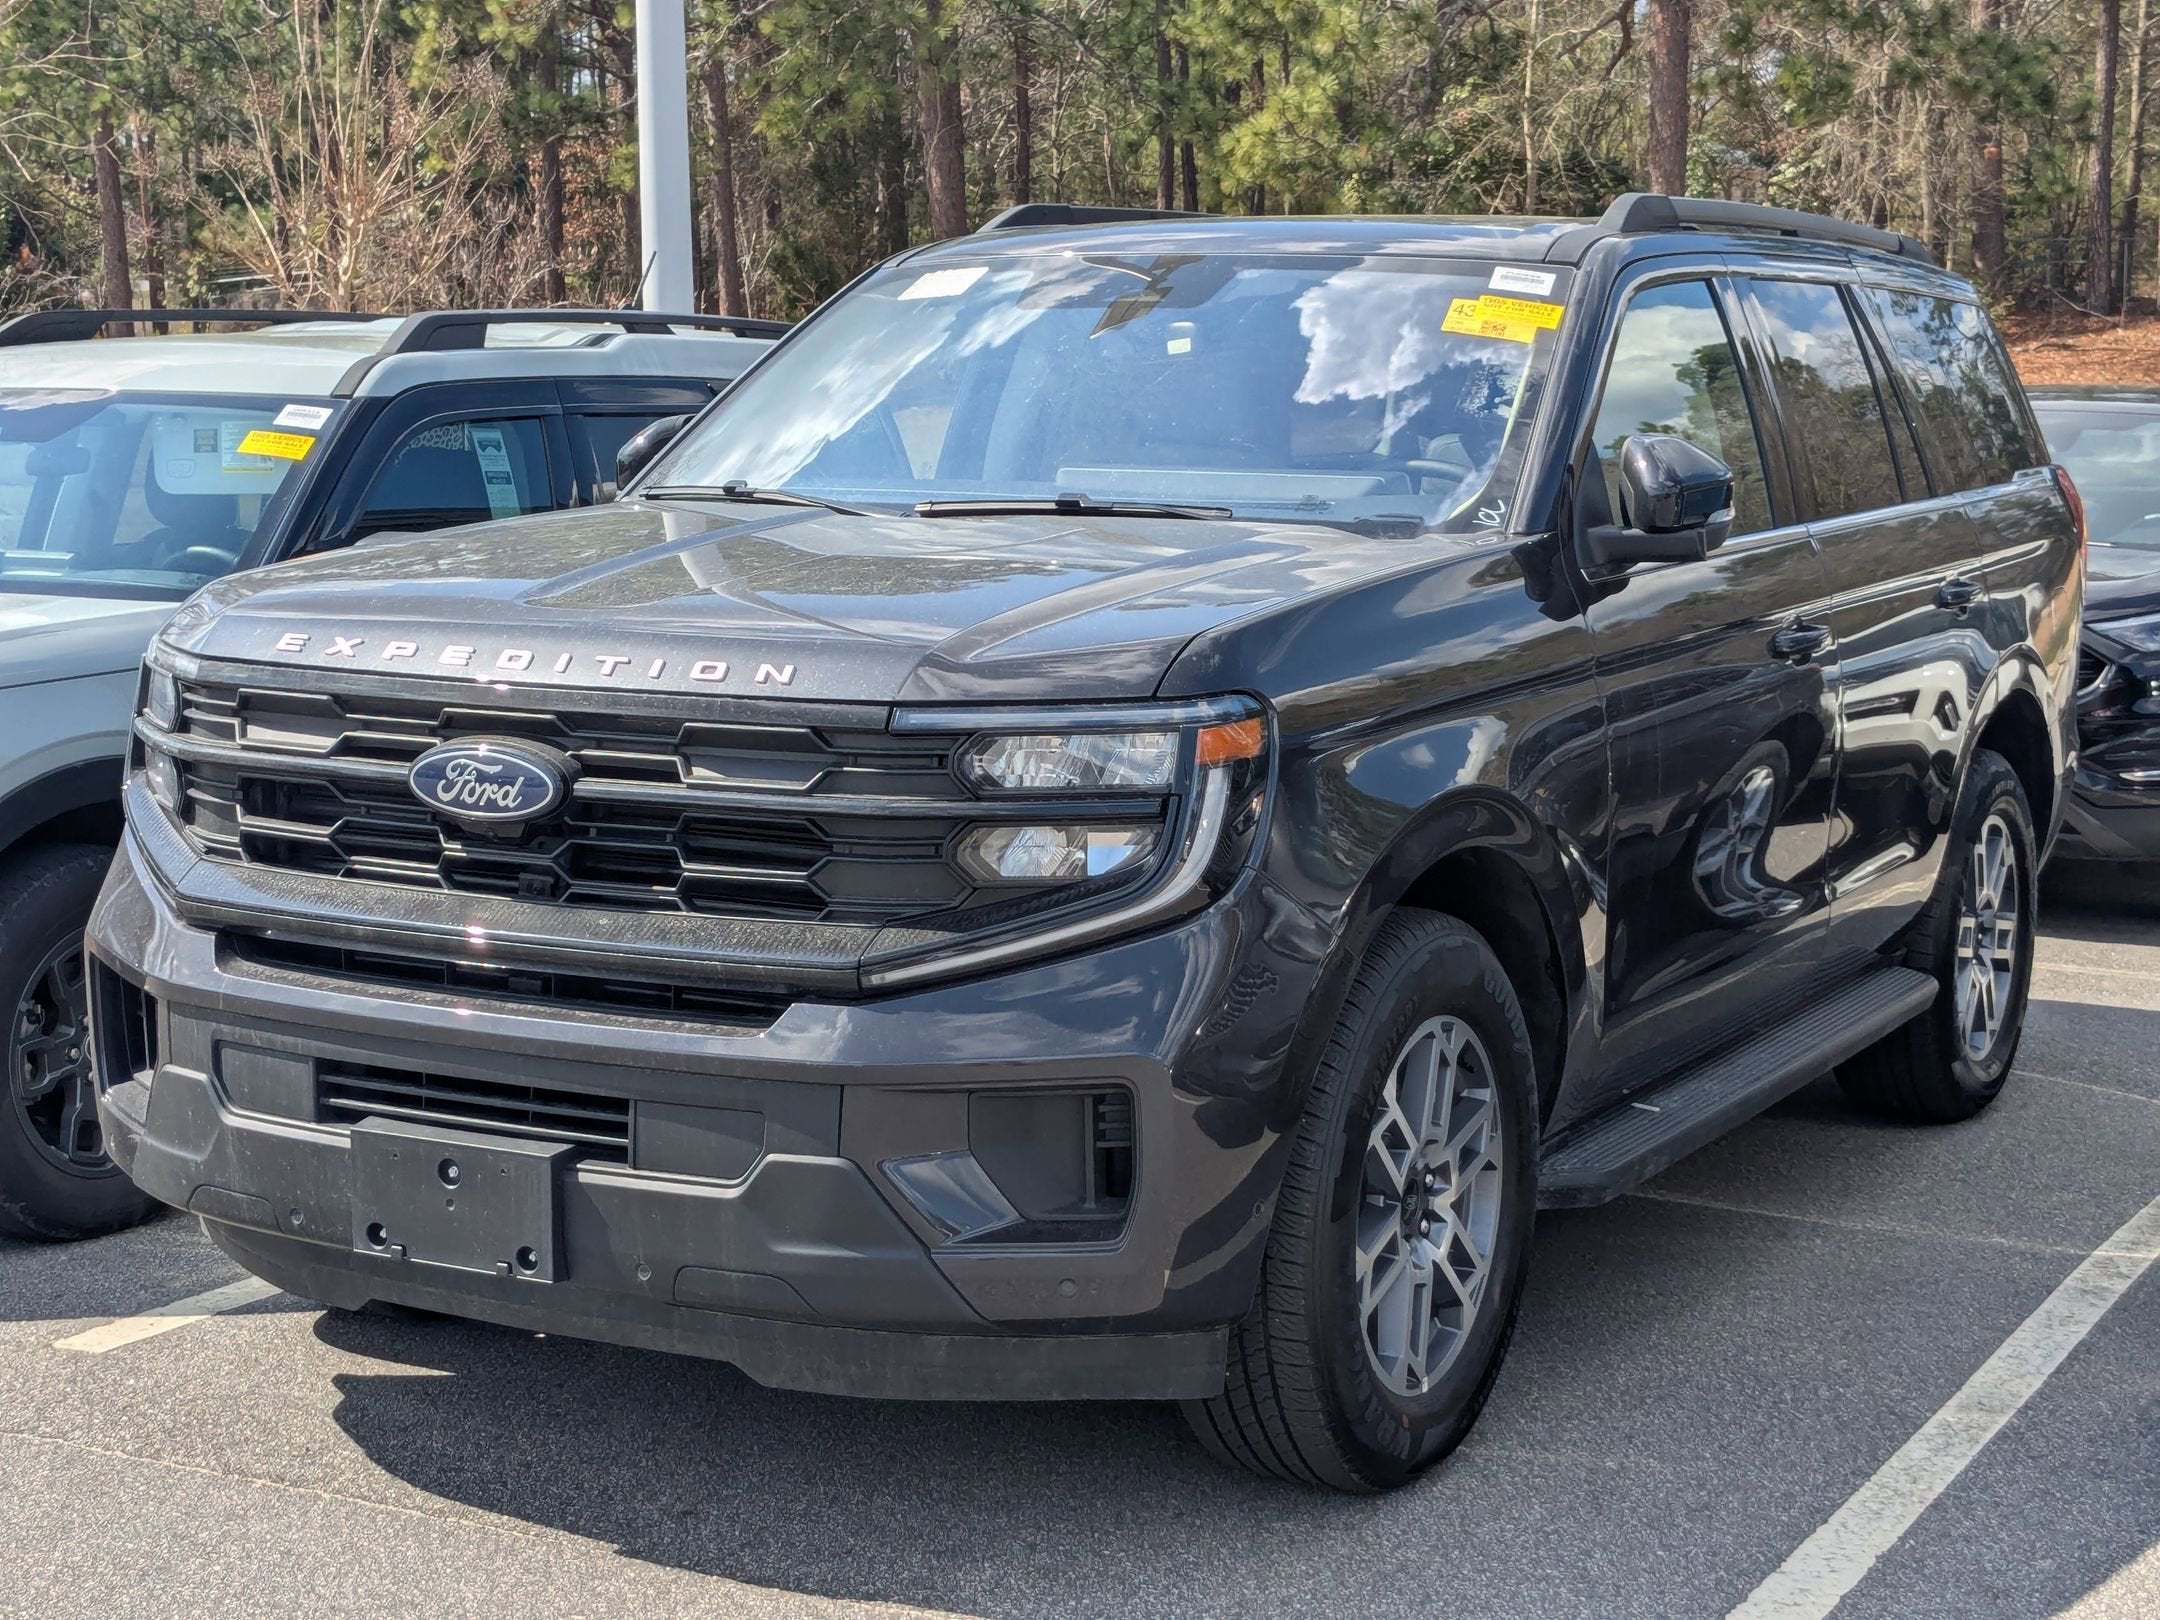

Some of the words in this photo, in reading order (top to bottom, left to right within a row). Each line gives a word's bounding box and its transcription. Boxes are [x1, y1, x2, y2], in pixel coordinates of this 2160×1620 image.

[1483, 297, 1508, 305] THIS
[1511, 301, 1555, 312] VEHICLE
[1505, 305, 1526, 313] FOR
[1528, 309, 1553, 318] SALE
[273, 435, 310, 444] VEHICLE
[275, 632, 799, 687] EXPEDITION
[436, 757, 523, 809] Ford
